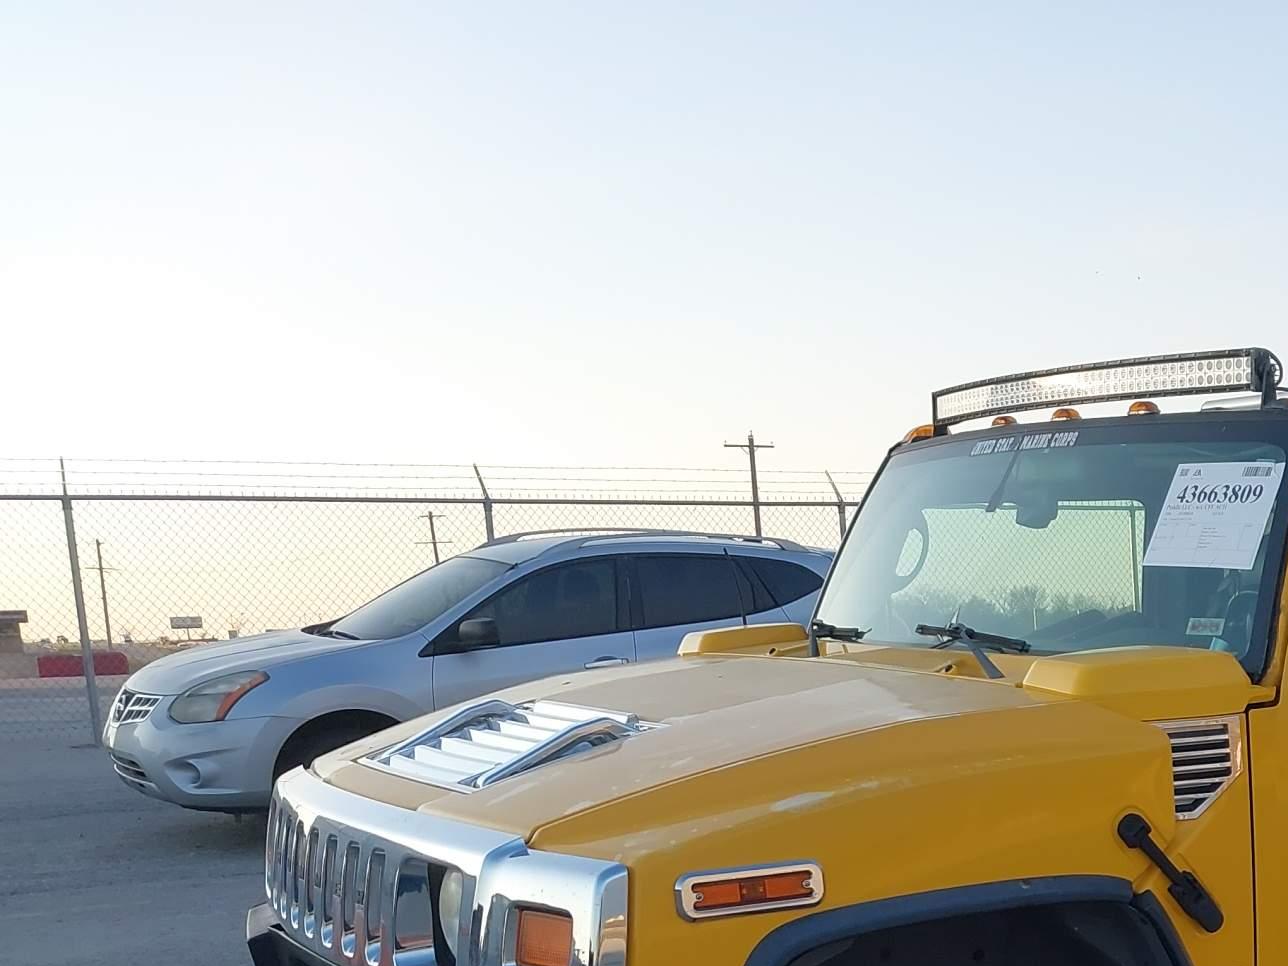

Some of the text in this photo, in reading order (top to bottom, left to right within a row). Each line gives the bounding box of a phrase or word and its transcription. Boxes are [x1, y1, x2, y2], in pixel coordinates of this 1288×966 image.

[1020, 434, 1051, 450] MARINE
[1051, 432, 1079, 448] CORPS
[1177, 484, 1264, 504] 43663809
